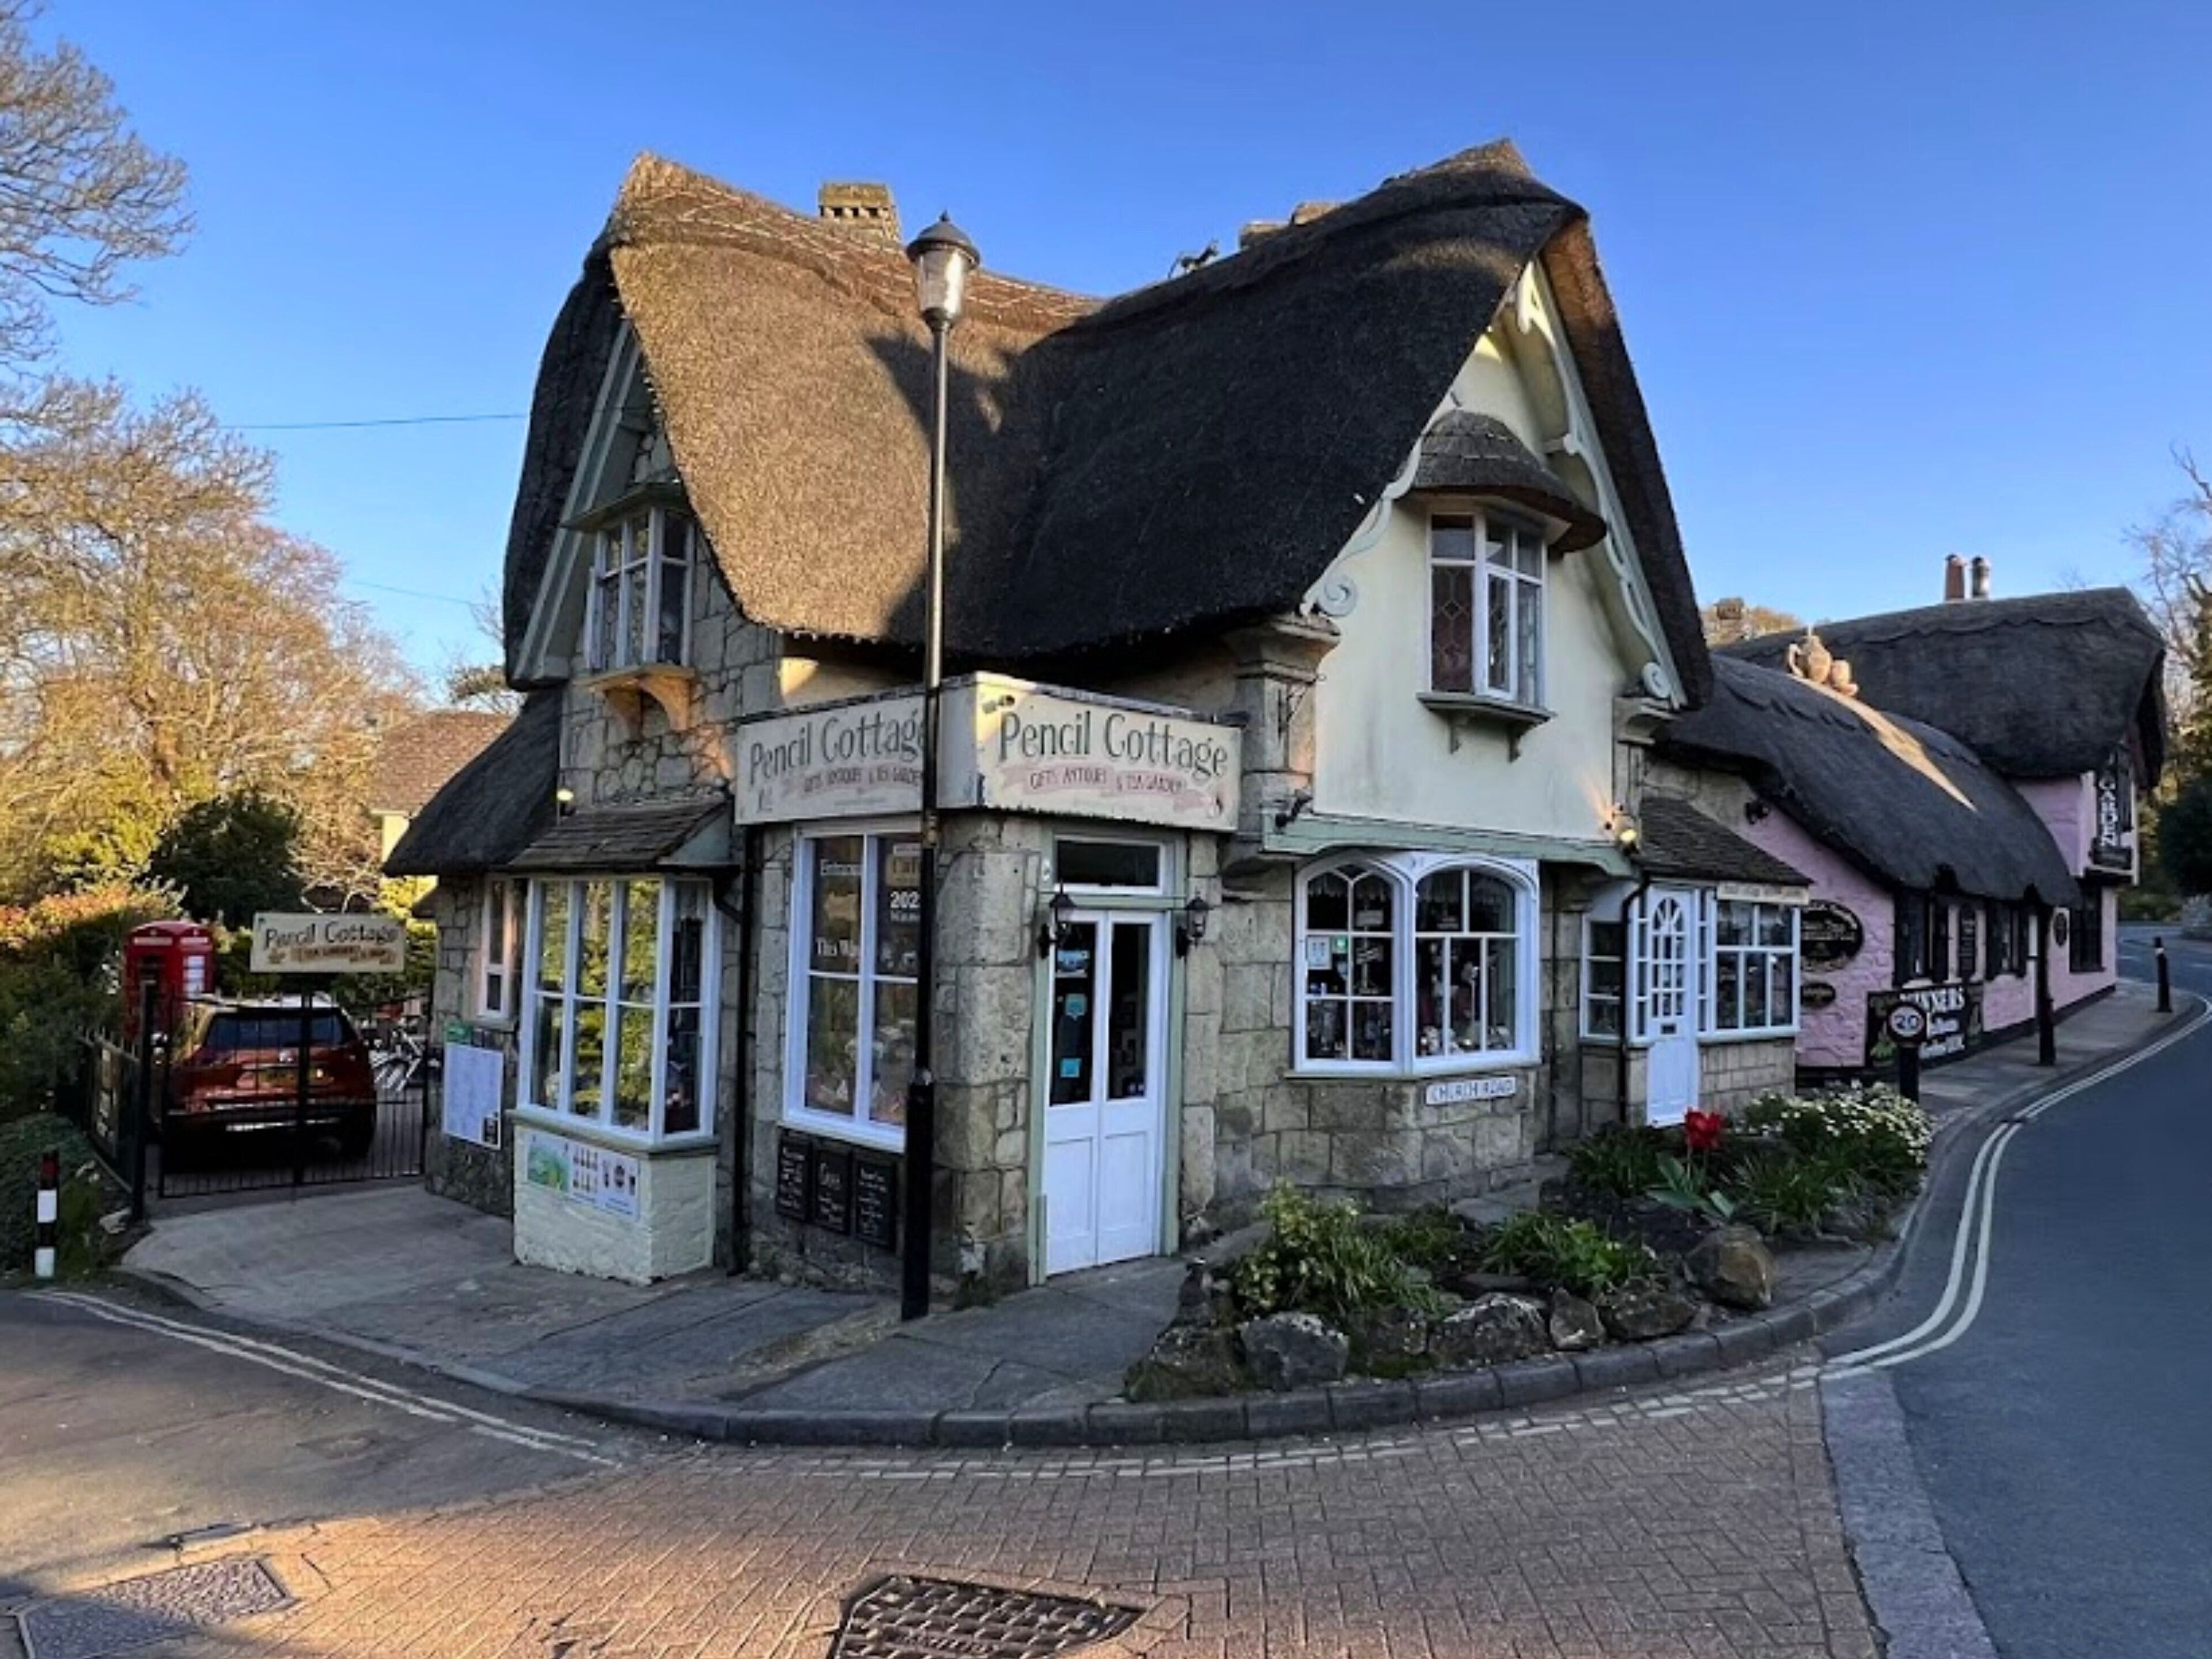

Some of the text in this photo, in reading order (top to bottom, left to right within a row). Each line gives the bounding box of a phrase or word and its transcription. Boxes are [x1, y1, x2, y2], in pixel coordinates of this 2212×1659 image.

[750, 722, 811, 785] Pencil
[999, 710, 1228, 781] Pencil Cottage
[890, 891, 921, 909] 202
[264, 921, 399, 950] Pencil Cottage
[1893, 1015, 1919, 1029] 20
[1432, 1080, 1512, 1102] CHURCH ROAD
